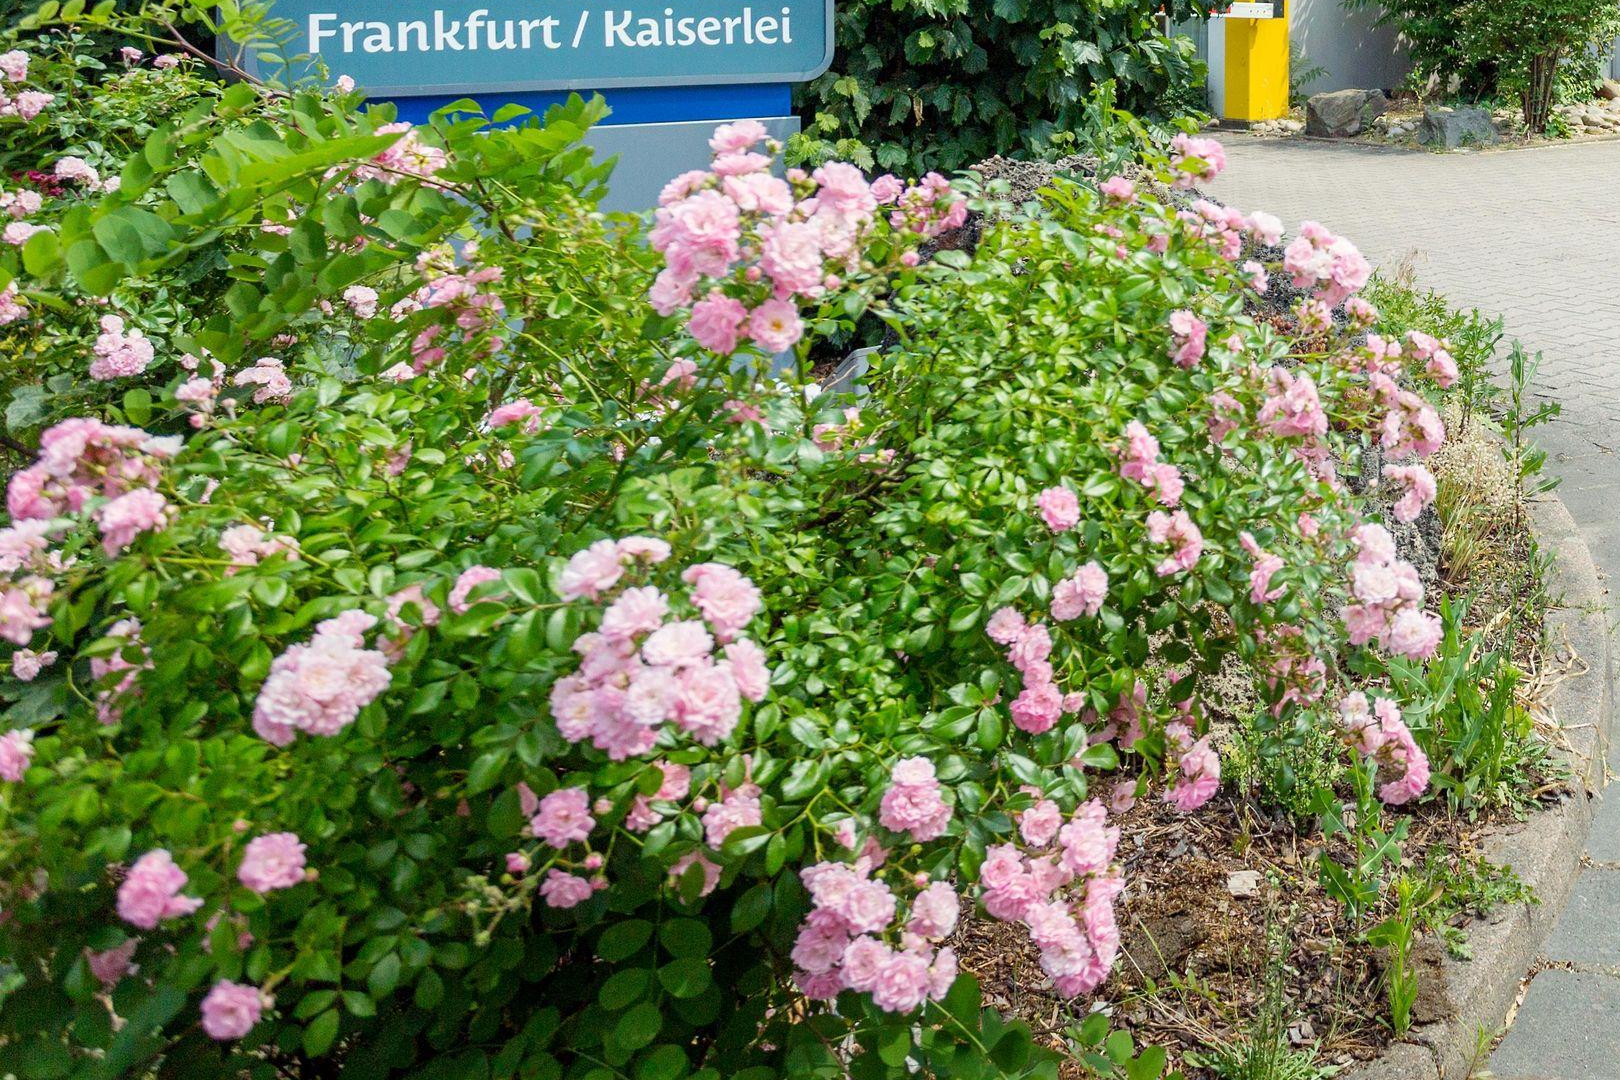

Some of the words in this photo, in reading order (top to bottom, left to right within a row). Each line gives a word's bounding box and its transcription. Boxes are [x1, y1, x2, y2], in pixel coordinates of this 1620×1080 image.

[308, 9, 562, 54] Frankfurt
[571, 10, 589, 48] /
[604, 6, 793, 47] Kaiserlei
